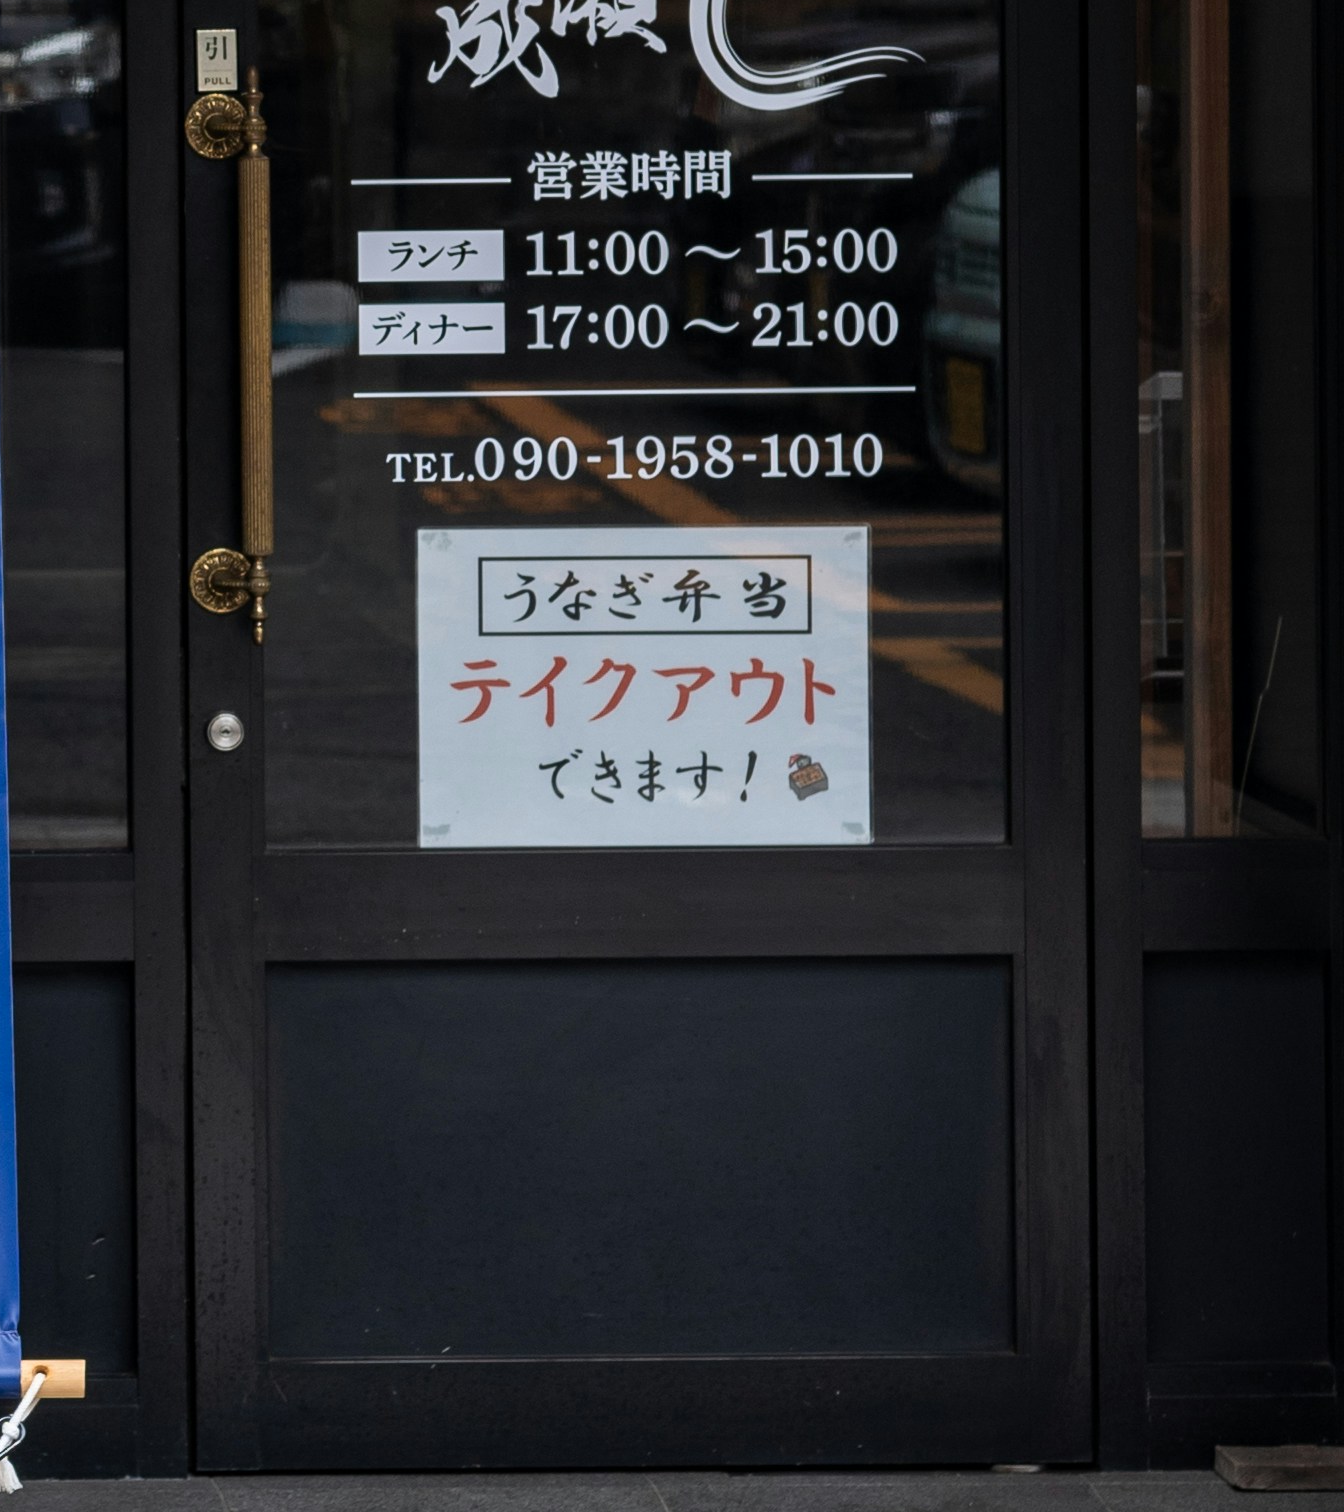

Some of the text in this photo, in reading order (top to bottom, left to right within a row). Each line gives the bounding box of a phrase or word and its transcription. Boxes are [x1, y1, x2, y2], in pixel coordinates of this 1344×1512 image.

[204, 36, 228, 61] 引
[204, 76, 232, 86] PULL
[526, 149, 732, 202] 営業時間
[388, 239, 479, 272] ランチ
[526, 230, 670, 276] 11:00
[755, 227, 898, 274] 15:00
[372, 312, 494, 346] ディナー
[526, 303, 669, 350] 17:00
[751, 301, 899, 347] 21:00
[503, 569, 787, 623] うなぎ弁当
[451, 655, 836, 727] テイクアウト
